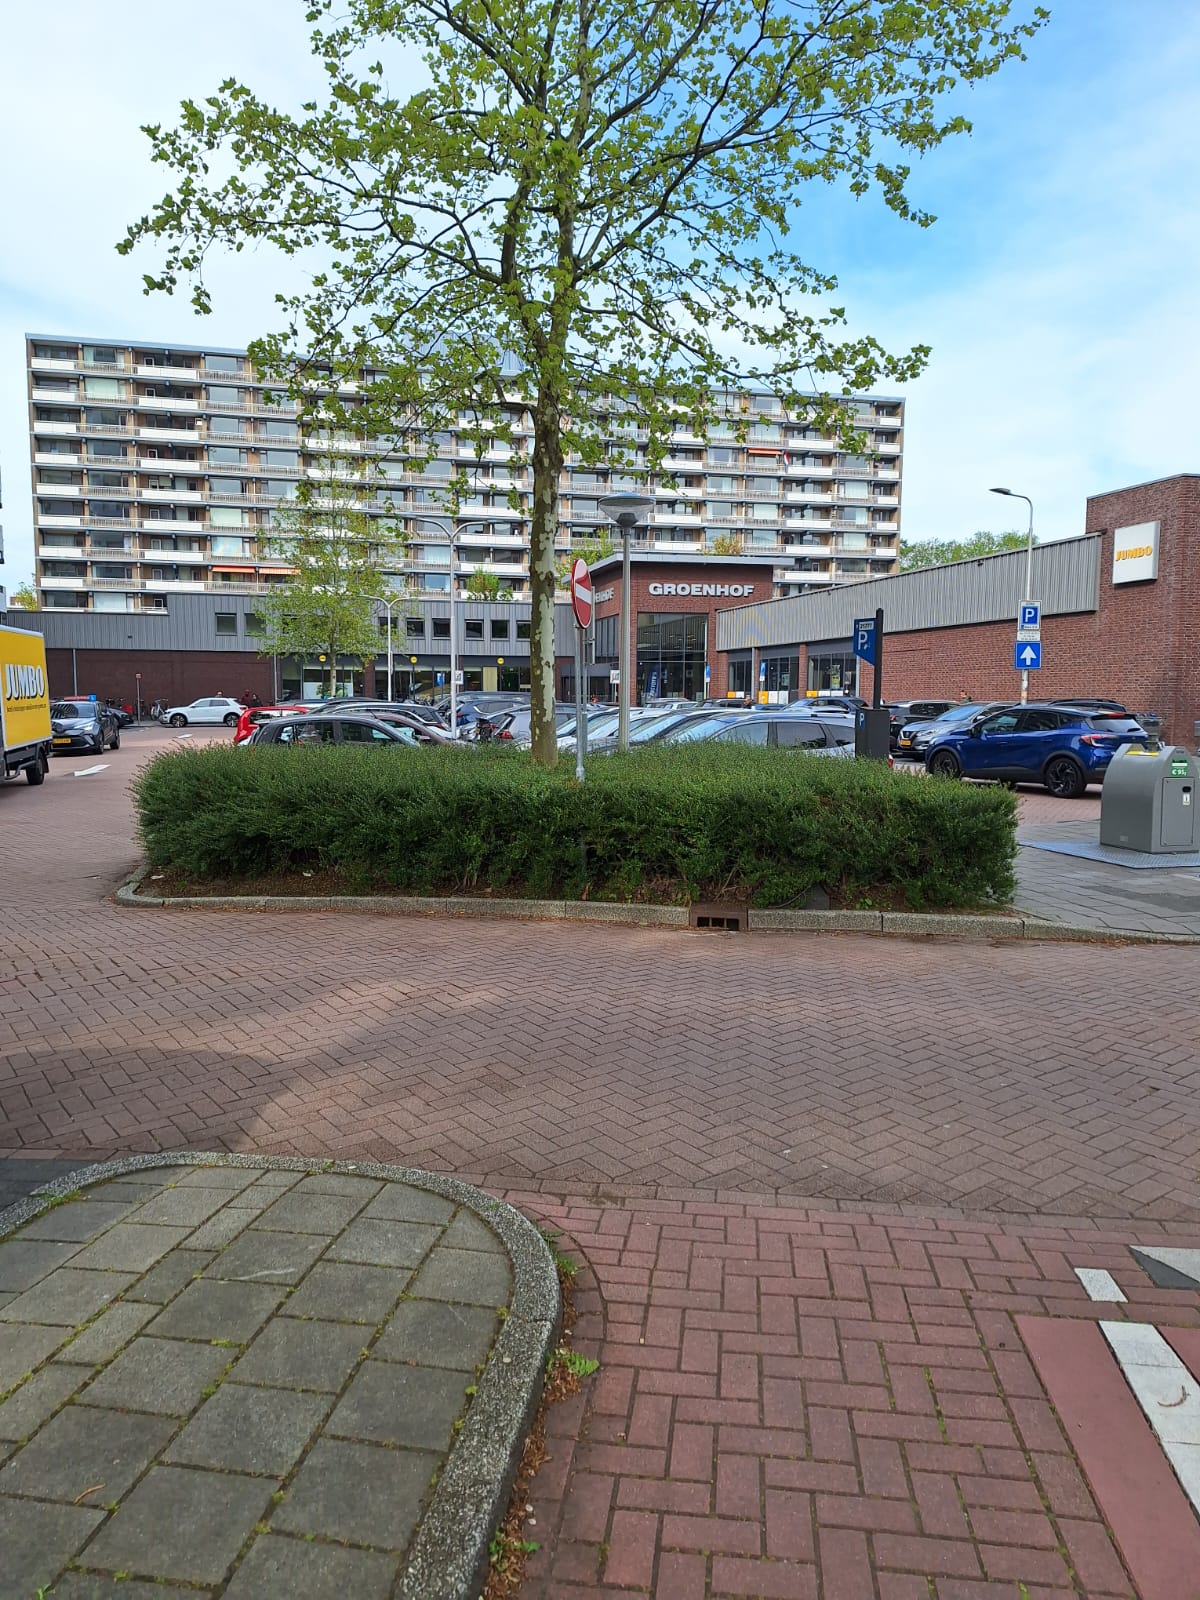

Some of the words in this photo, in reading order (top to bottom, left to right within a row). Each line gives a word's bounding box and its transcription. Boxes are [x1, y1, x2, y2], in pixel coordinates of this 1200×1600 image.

[1115, 545, 1153, 561] JUMBO
[648, 582, 755, 598] GROENHOF
[1025, 608, 1035, 623] P
[858, 631, 868, 650] P
[5, 663, 46, 701] JUMBO
